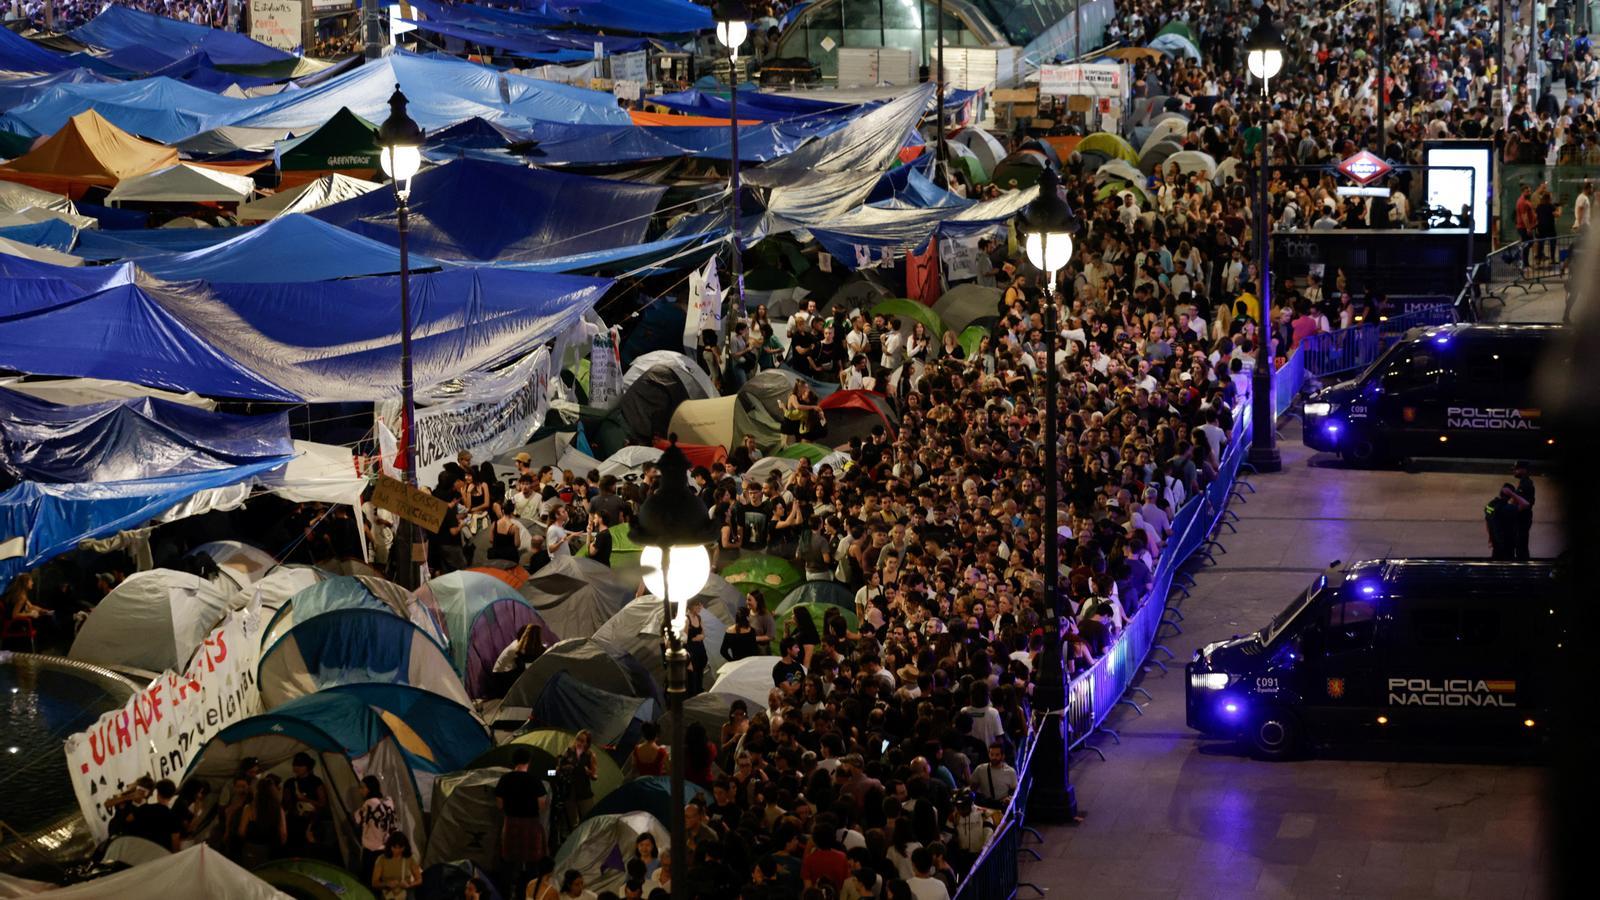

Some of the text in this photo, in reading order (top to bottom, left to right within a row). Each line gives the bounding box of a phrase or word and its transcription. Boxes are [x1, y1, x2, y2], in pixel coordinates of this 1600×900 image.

[1448, 407, 1522, 418] POLICIA
[1448, 419, 1541, 430] NACIONAL
[1388, 678, 1490, 692] POLICIA
[1389, 694, 1516, 707] NACIONAL
